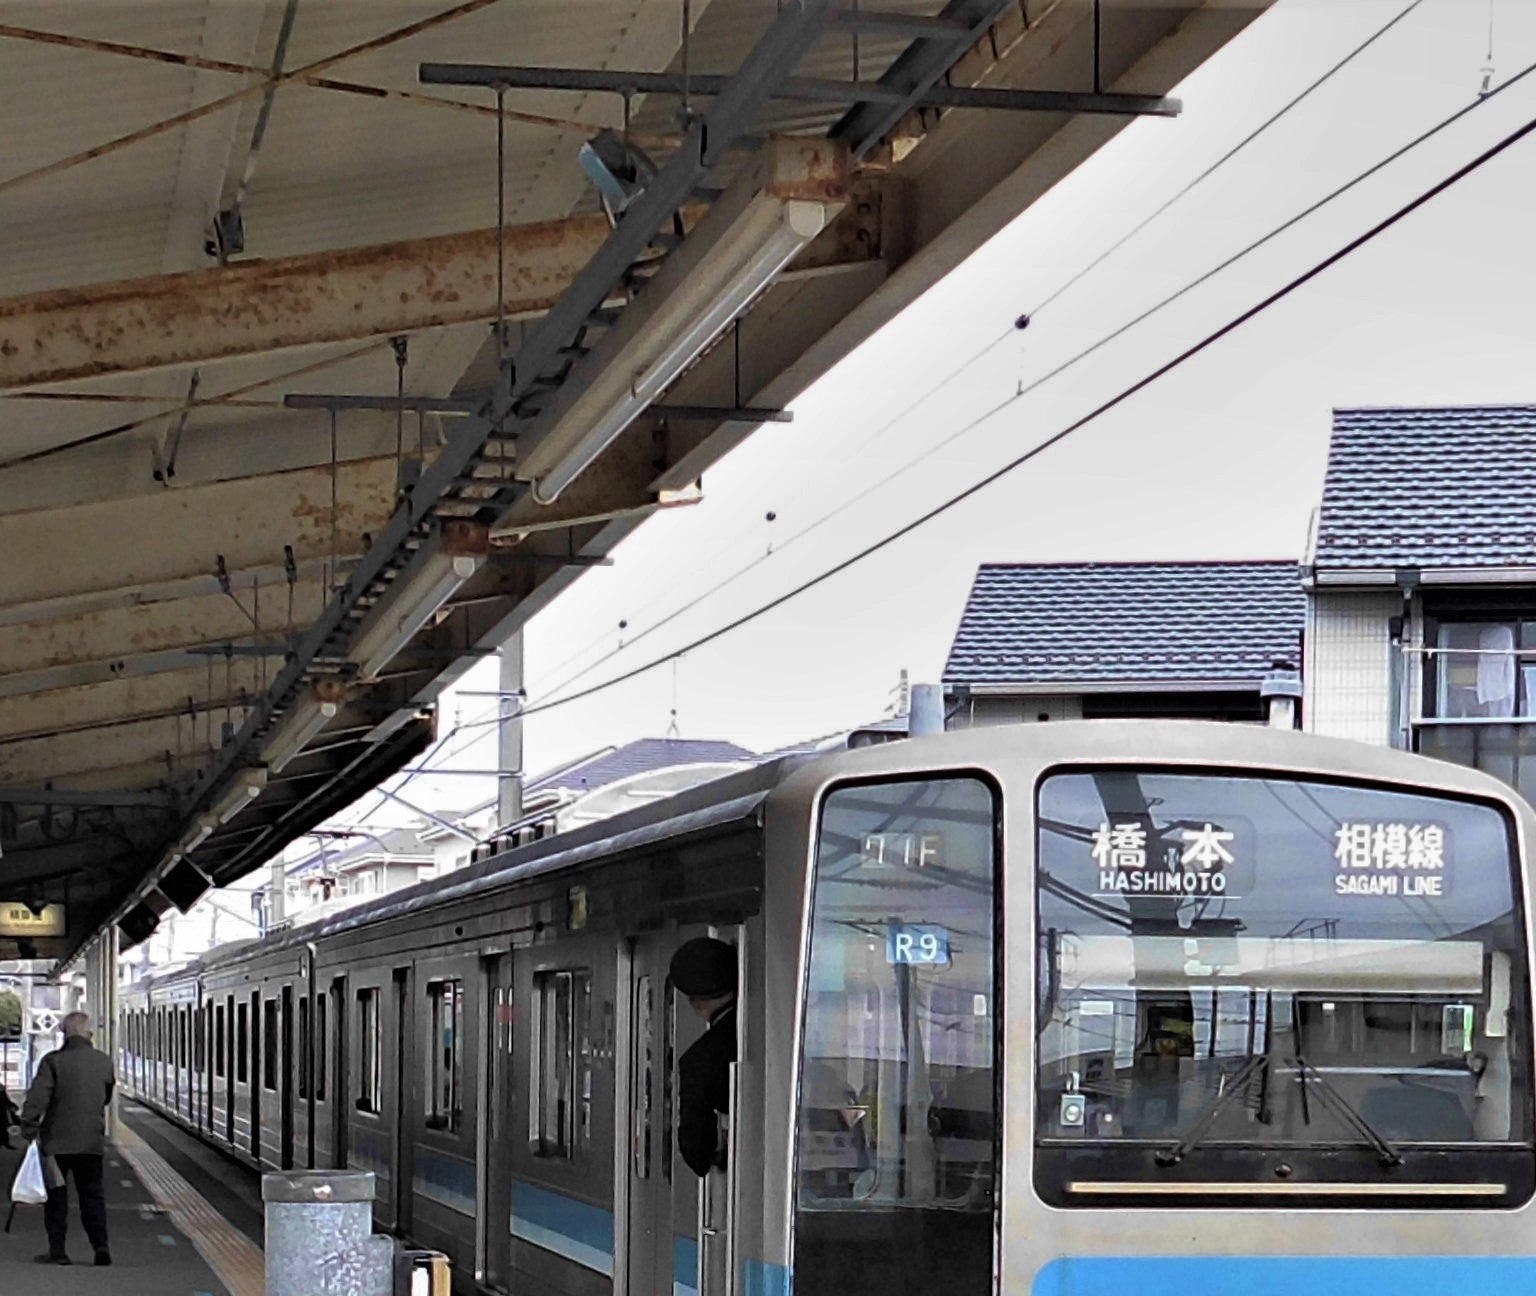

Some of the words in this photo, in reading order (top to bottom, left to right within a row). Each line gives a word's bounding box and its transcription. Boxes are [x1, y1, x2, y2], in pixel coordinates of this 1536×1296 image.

[1091, 822, 1235, 869] 橋本
[1334, 824, 1445, 870] 相模線
[1099, 871, 1227, 893] HASHIMOTO
[1335, 875, 1397, 896] SAGAMI
[1402, 875, 1443, 896] LINE
[895, 933, 939, 961] R9
